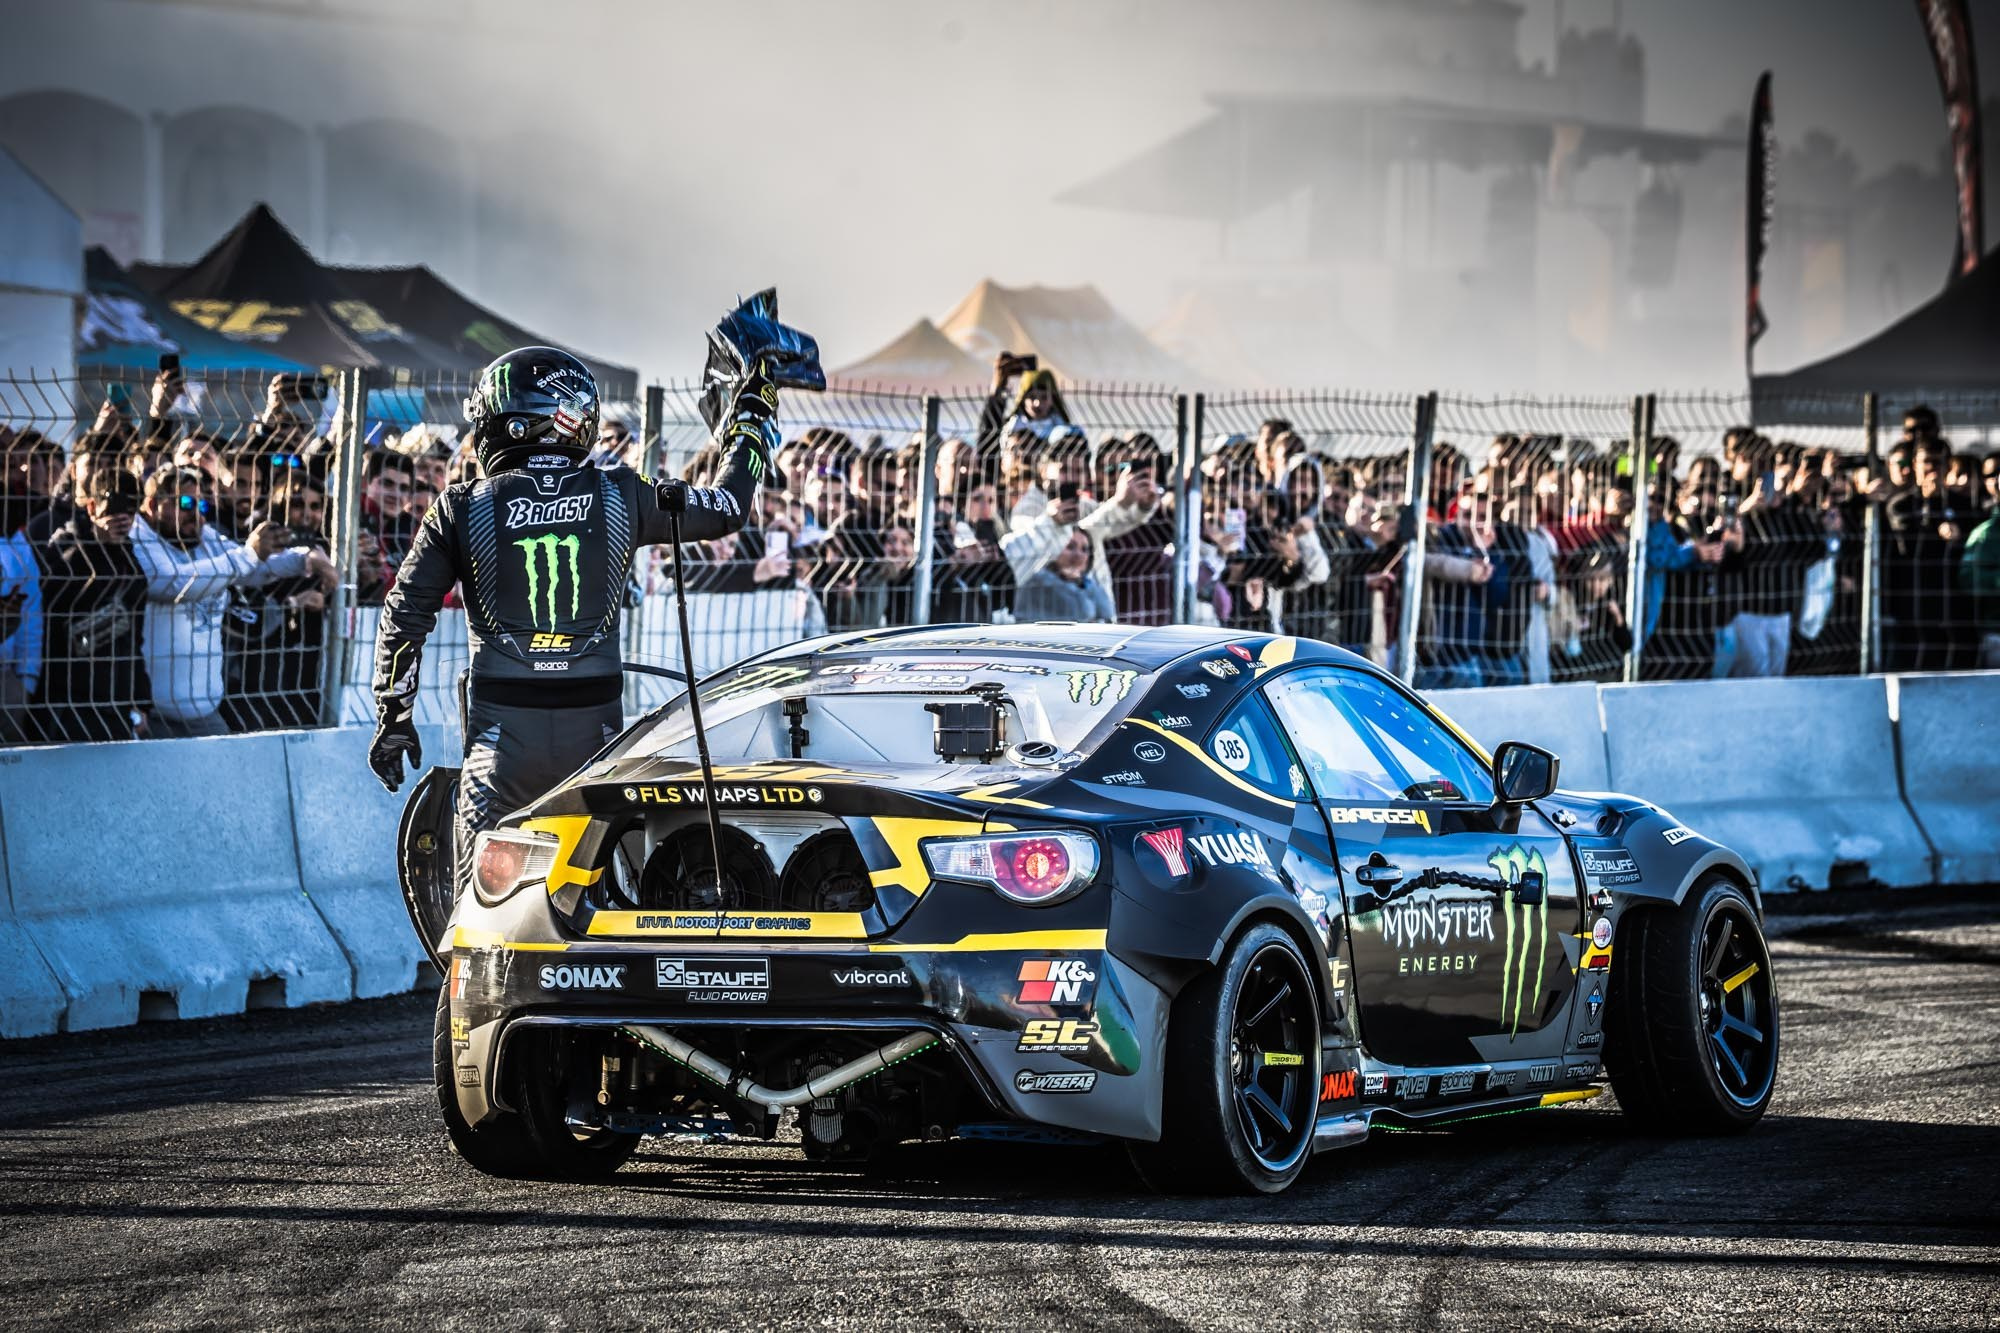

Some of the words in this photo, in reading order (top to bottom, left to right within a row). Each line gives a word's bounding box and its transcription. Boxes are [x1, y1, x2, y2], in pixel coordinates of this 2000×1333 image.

[536, 369, 567, 389] Send
[505, 494, 593, 529] BAGGSY
[530, 633, 575, 648] st
[534, 661, 568, 671] sparco
[881, 675, 967, 684] YUASA
[1140, 749, 1161, 759] HEL
[1102, 770, 1143, 785] STRÖM
[639, 787, 682, 803] FLS
[762, 787, 805, 803] LTD
[1188, 832, 1272, 867] YUASA
[1595, 860, 1634, 872] STAUFF
[1615, 873, 1640, 883] POWER
[636, 916, 672, 928] LITUTA
[755, 917, 811, 930] GRAPHICS
[1400, 955, 1477, 972] ENERGY
[540, 967, 623, 988] SONAX
[685, 971, 767, 986] STAUFF
[833, 970, 908, 985] vibrant
[1047, 961, 1095, 982] K&
[688, 991, 721, 1000] FLUID
[722, 991, 767, 1001] POWER
[1051, 981, 1081, 1002] N
[1021, 1020, 1097, 1044] st
[1578, 1032, 1600, 1045] Garrett
[1035, 1076, 1095, 1089] WISEFAB
[1366, 1077, 1383, 1087] COMP
